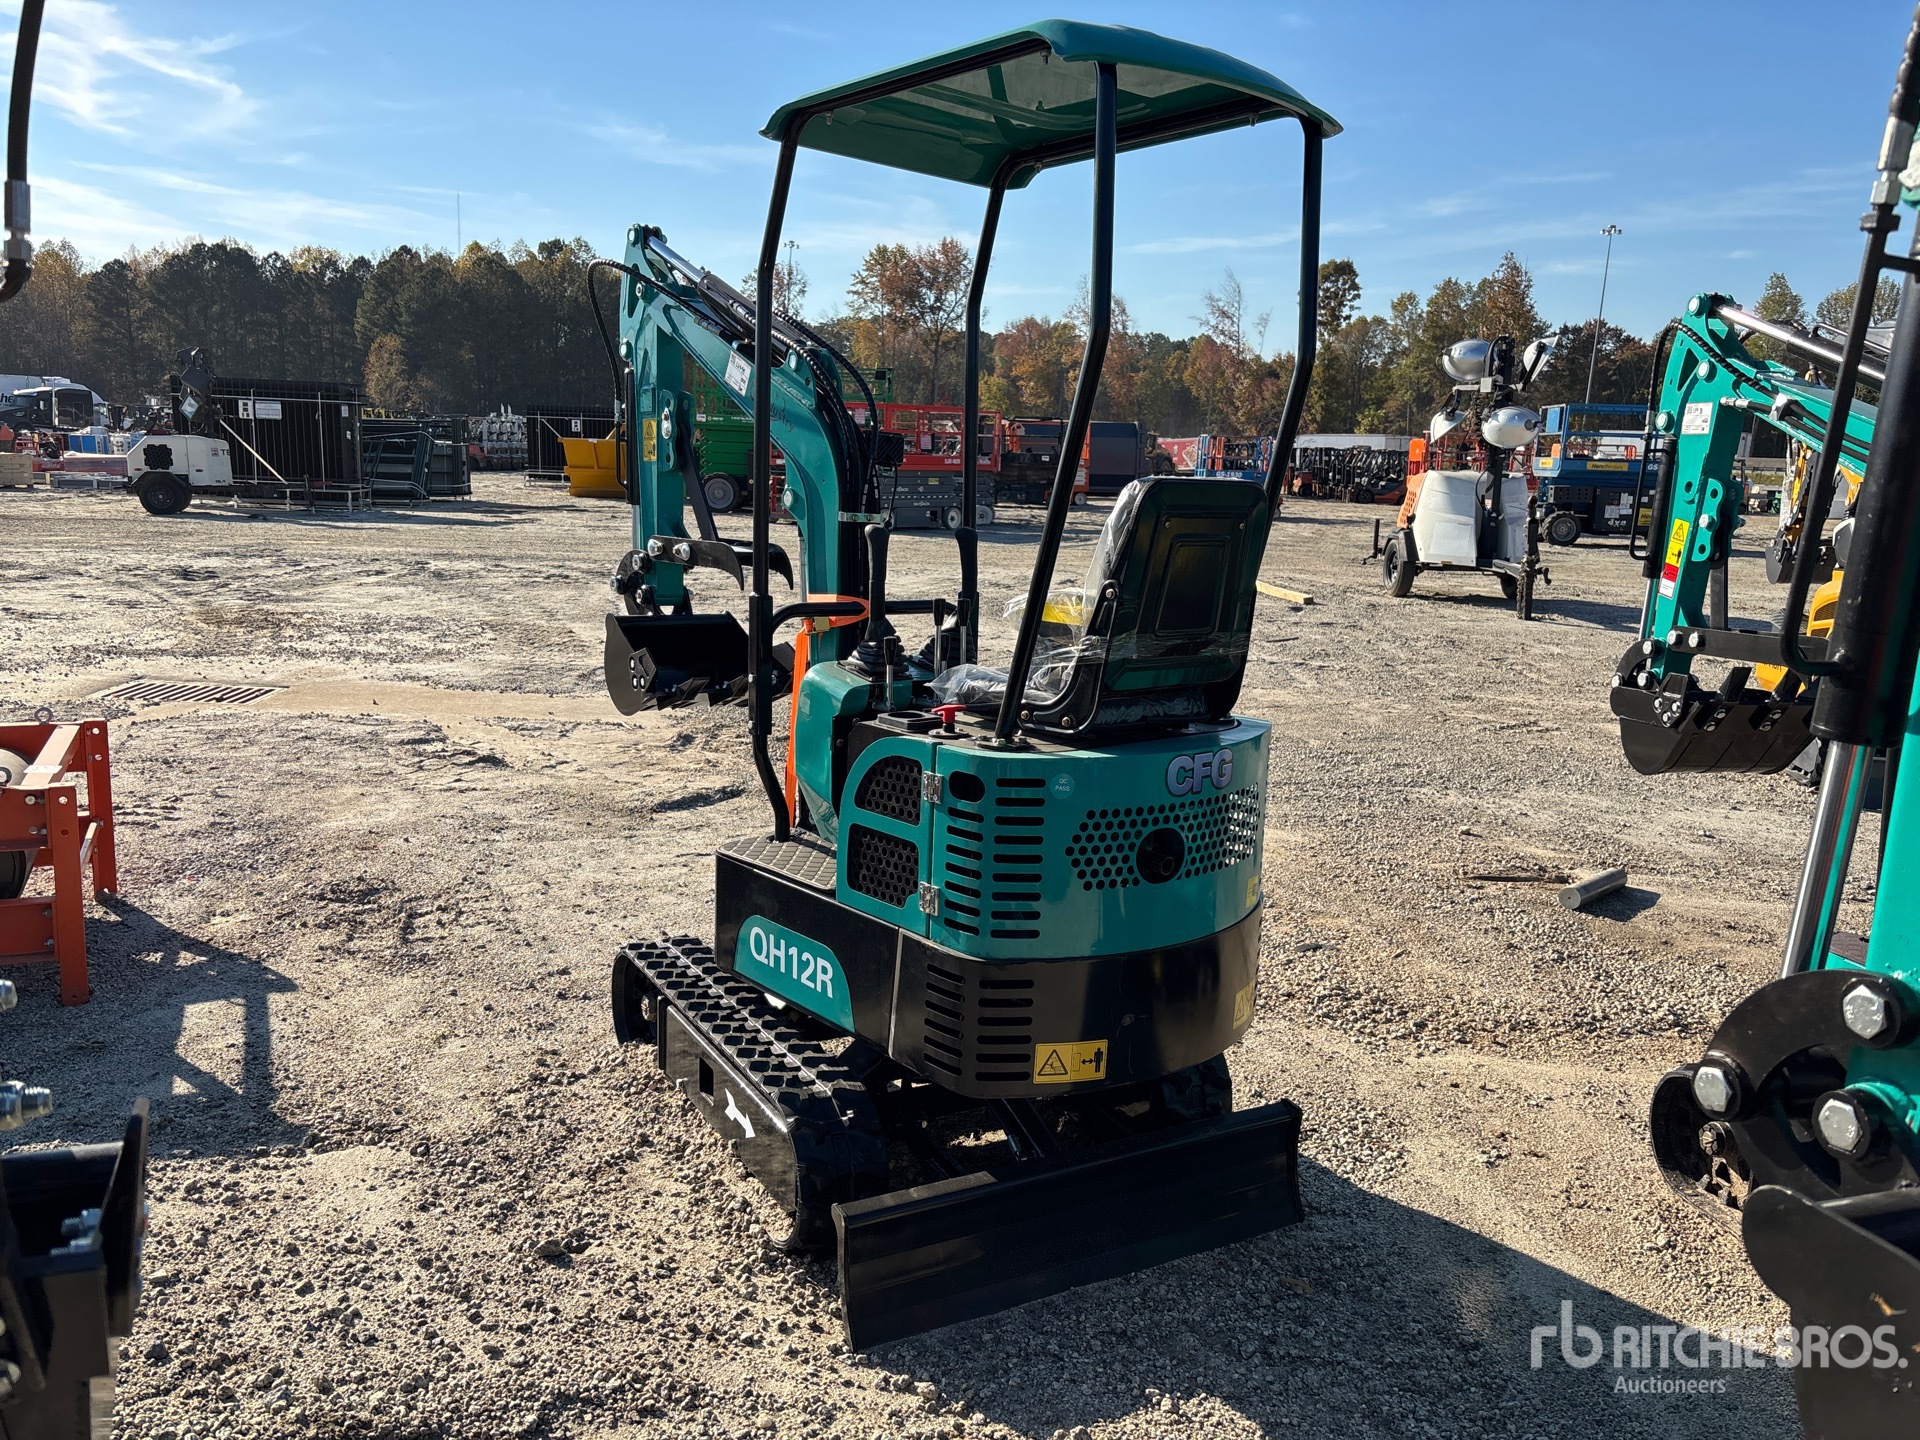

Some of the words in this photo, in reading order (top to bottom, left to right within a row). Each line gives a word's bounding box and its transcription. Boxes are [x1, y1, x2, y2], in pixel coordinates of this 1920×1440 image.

[1054, 784, 1070, 792] PASS
[1165, 747, 1234, 797] CFG
[749, 926, 833, 999] QH12R
